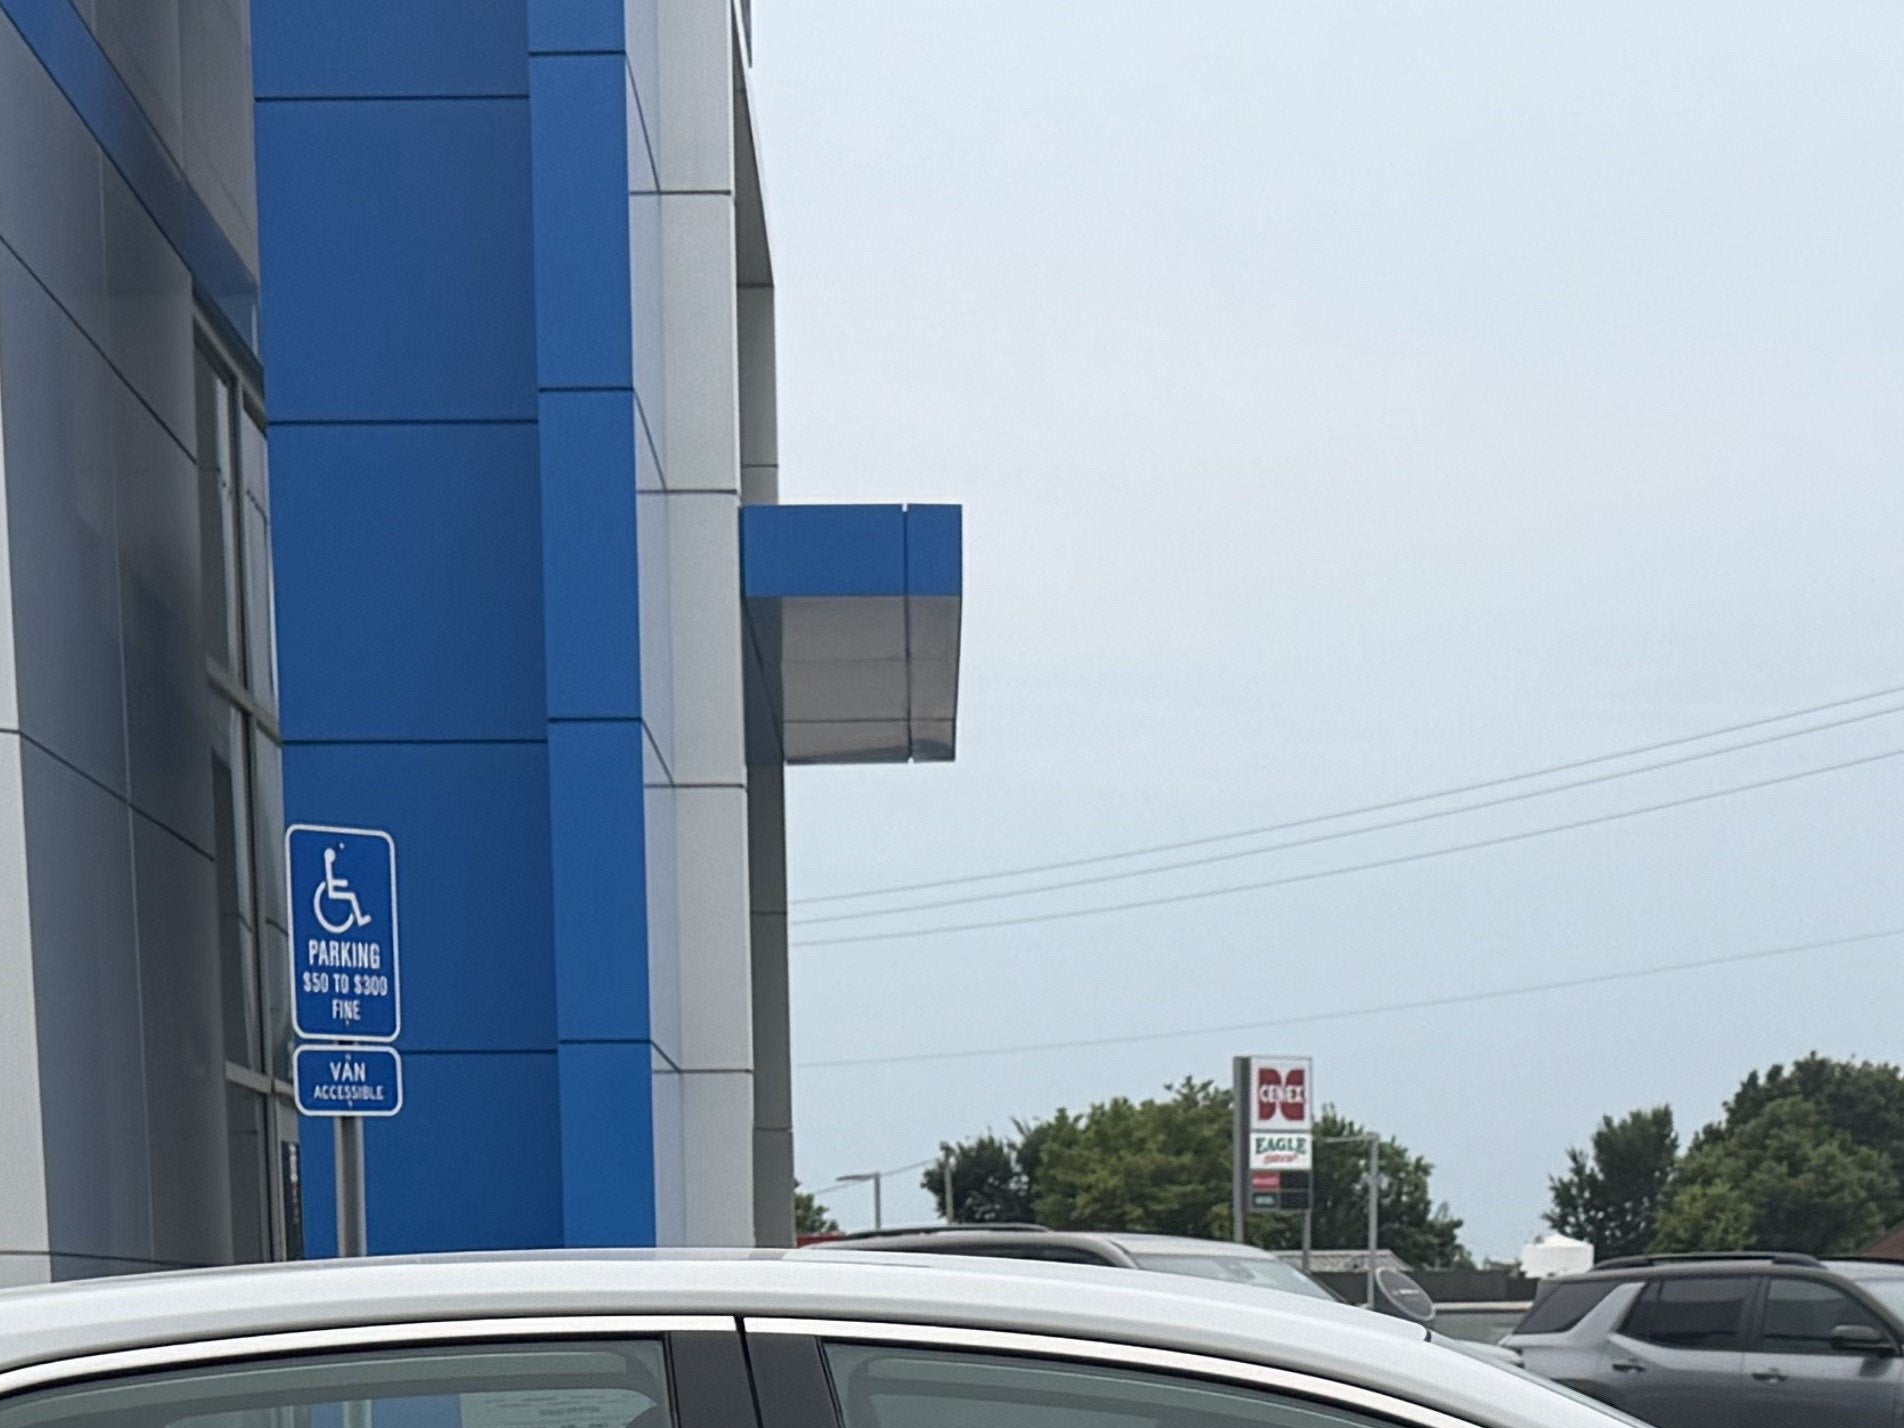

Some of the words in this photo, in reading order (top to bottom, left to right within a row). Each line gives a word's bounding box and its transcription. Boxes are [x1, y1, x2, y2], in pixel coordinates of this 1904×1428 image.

[308, 939, 381, 969] PARKING
[303, 972, 329, 993] $50
[333, 973, 349, 994] TO
[354, 974, 388, 996] $300
[332, 999, 361, 1020] FINE
[330, 1061, 366, 1082] VAN
[313, 1085, 384, 1100] ACCESSIBLE
[1255, 1136, 1306, 1154] EAGLE
